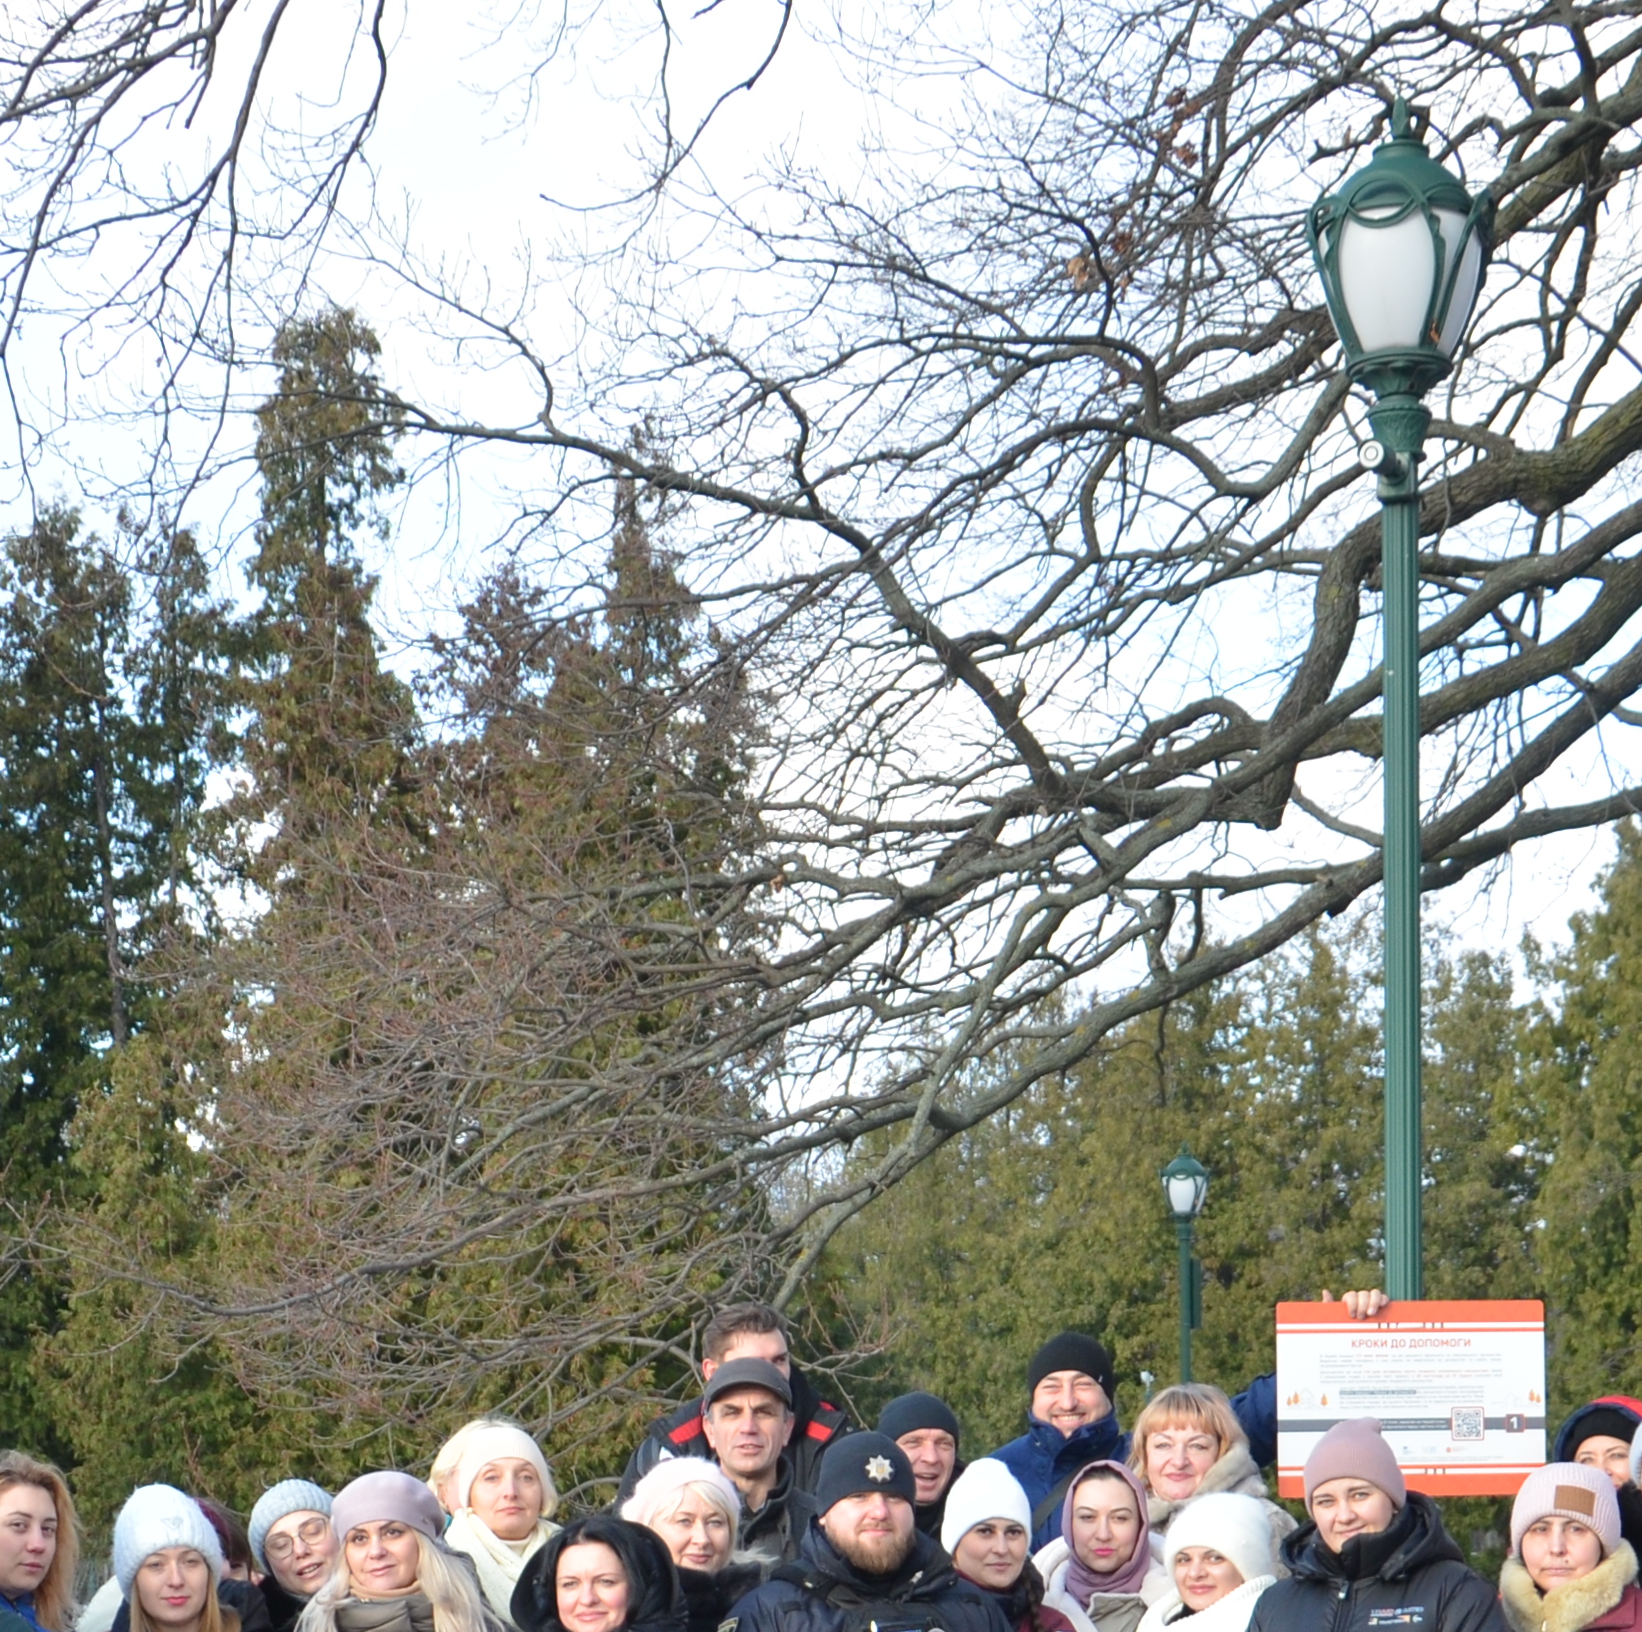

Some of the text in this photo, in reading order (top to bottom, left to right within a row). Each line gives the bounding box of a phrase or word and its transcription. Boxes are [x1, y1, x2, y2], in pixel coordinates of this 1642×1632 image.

[1351, 1338, 1472, 1349] КРОКИ ДО ДОПОМОГИ
[1509, 1416, 1519, 1430] 1
